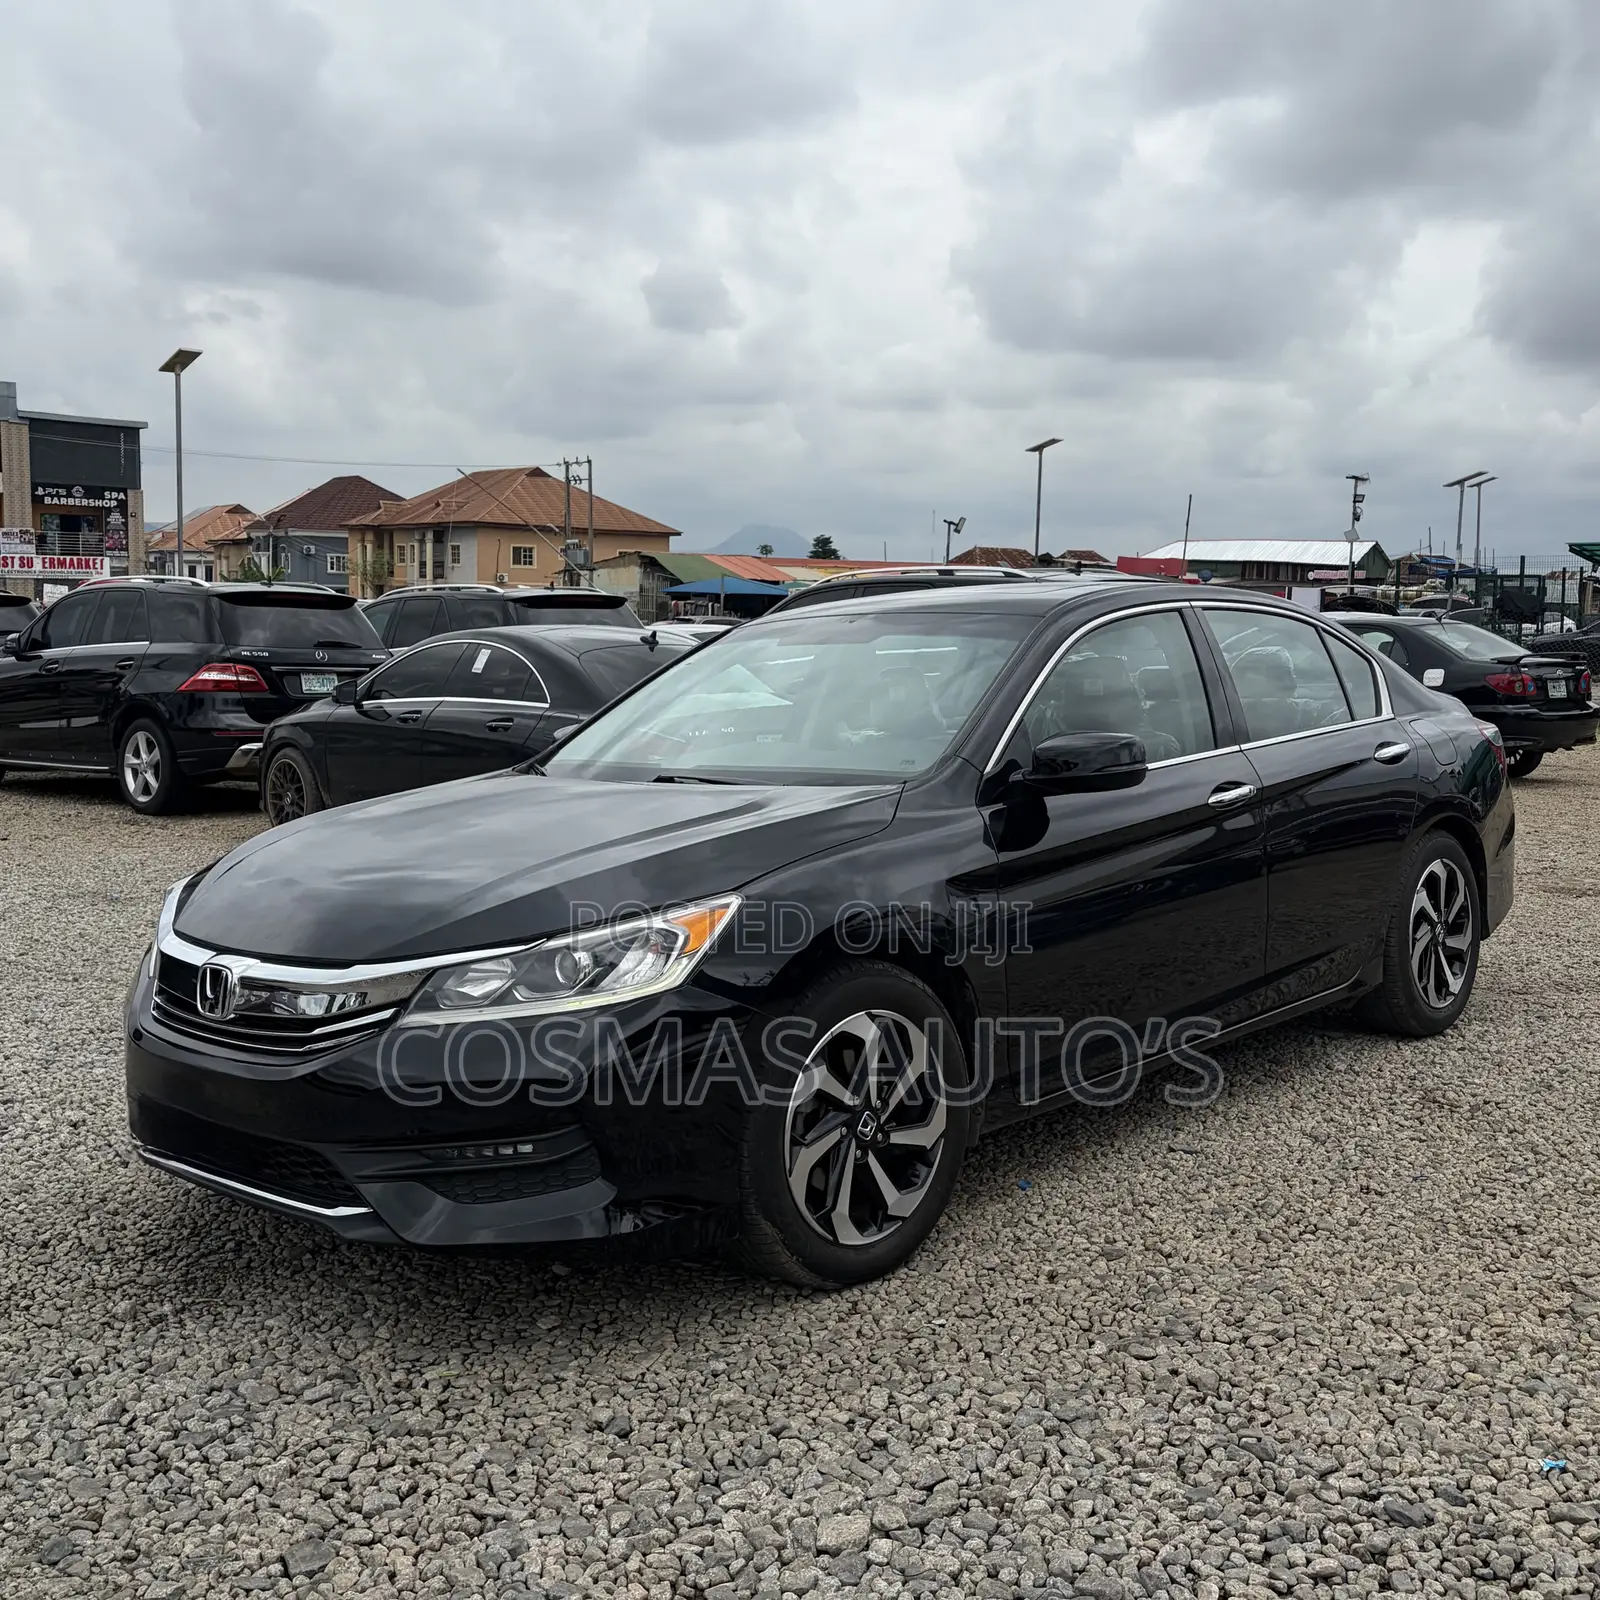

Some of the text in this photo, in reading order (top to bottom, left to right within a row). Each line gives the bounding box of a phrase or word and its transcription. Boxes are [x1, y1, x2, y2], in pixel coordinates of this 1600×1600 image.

[104, 491, 126, 500] SPA
[44, 496, 117, 508] BARBERSHOP
[0, 555, 104, 570] ST SUERMARKET
